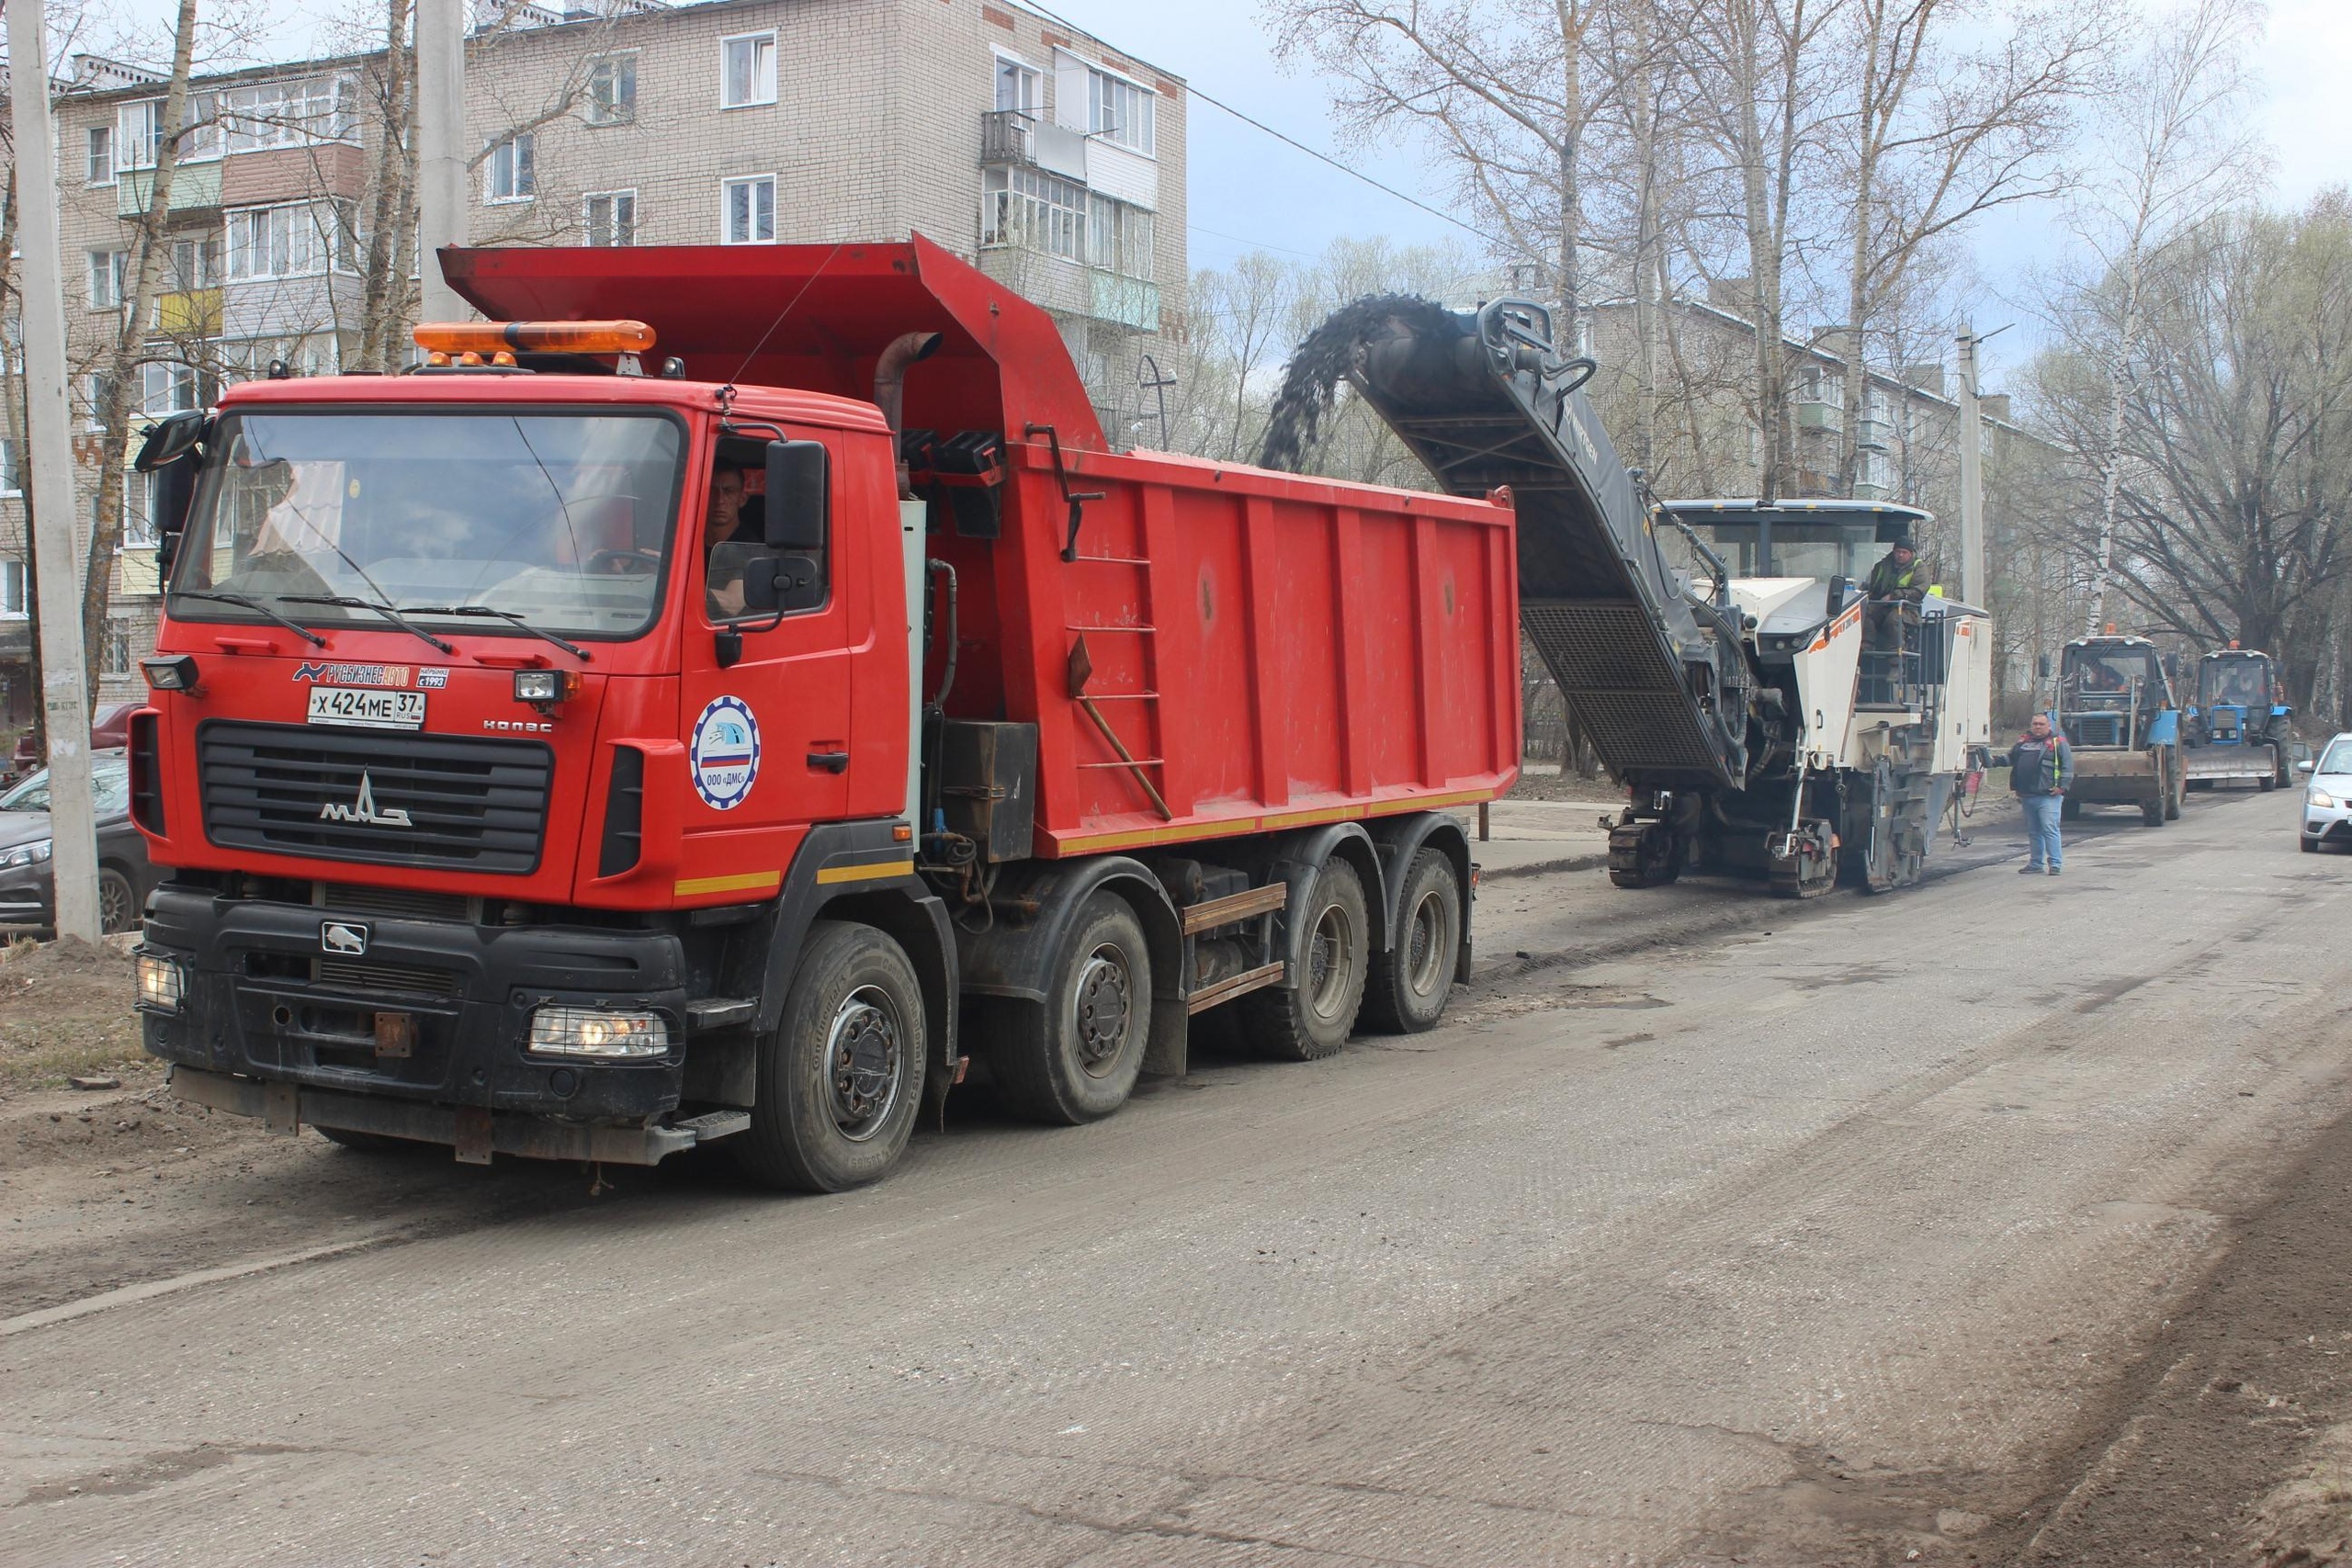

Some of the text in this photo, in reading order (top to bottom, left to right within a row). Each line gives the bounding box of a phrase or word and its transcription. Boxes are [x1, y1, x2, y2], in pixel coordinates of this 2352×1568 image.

[1572, 412, 1598, 466] WIRTGEN
[326, 664, 410, 686] РУСБИЗНЕСАВТО
[425, 676, 445, 687] 1993
[398, 694, 418, 713] 37
[707, 774, 721, 785] ООО
